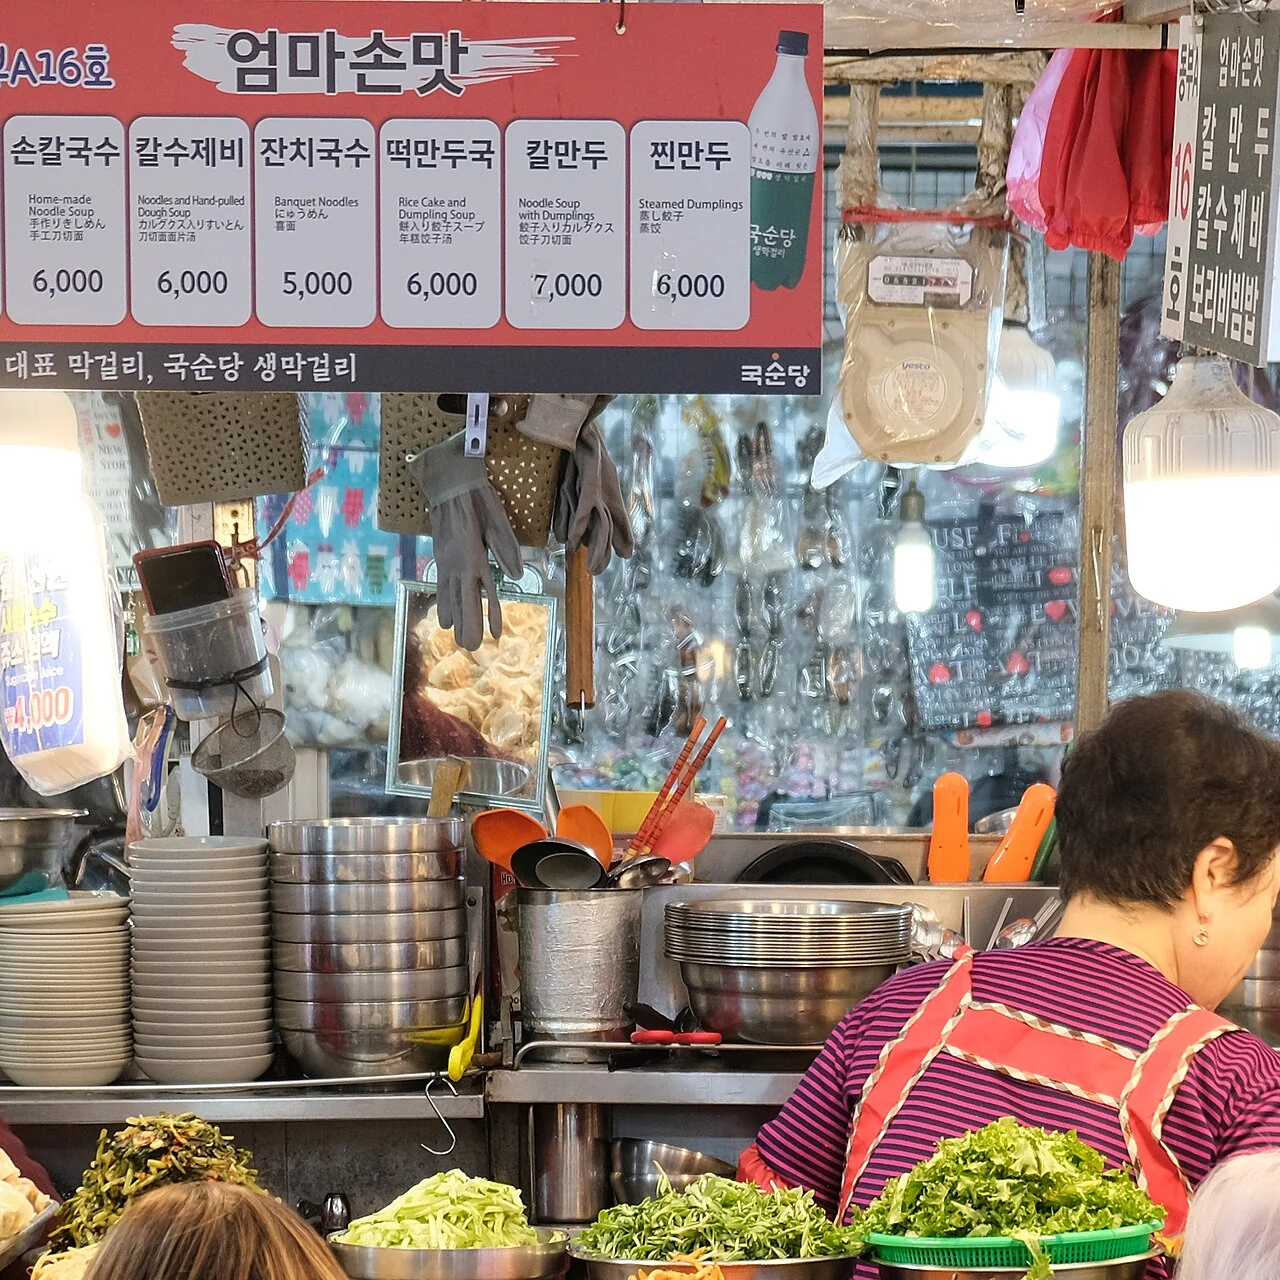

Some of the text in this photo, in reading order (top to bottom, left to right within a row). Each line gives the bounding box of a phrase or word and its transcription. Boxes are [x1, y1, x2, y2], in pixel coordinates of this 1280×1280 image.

[225, 30, 470, 97] 엄마손맛
[1219, 35, 1265, 88] 엄마손맛
[10, 136, 120, 167] 손칼국수
[135, 137, 244, 167] 칼수제비
[260, 137, 371, 168] 잔치국수
[386, 139, 495, 169] 떡만두국
[526, 140, 608, 170] 칼만두
[1201, 103, 1270, 178] 칼만두
[650, 141, 731, 171] 찐만두
[1174, 142, 1194, 221] 16
[28, 194, 92, 205] Home-made
[28, 206, 94, 219] Noodle Soup
[138, 195, 245, 207] Noodles and Hand-pulled
[138, 207, 191, 219] Dough Soup
[274, 197, 359, 209] Banquet Noodles
[275, 208, 328, 219] にゅうめん
[399, 197, 466, 207] Rice Cake and
[519, 198, 581, 211] Noodle Soup
[639, 199, 744, 212] Steamed Dumplings
[30, 218, 106, 229] 手作りきしめん
[399, 209, 476, 222] Dumpling Soup
[519, 210, 595, 223] with Dumplings
[1196, 182, 1265, 264] 칼수제비
[30, 230, 84, 241] 手工刀切面
[750, 224, 796, 248] 국순당
[752, 245, 785, 258] 생막걸리
[33, 269, 103, 298] 6,000
[157, 270, 228, 299] 6,000
[283, 271, 352, 300] 5,000
[407, 272, 477, 301] 6,000
[533, 274, 602, 302] 7,000
[657, 274, 725, 303] 6,000
[1166, 246, 1184, 322] 호
[1189, 263, 1260, 347] 보리비빔밥
[5, 351, 58, 381] 대표
[68, 351, 154, 384] 막걸리,
[163, 352, 243, 383] 국순당
[253, 352, 358, 383] 생막걸리
[741, 355, 811, 388] 국순당
[902, 362, 931, 370] yesco
